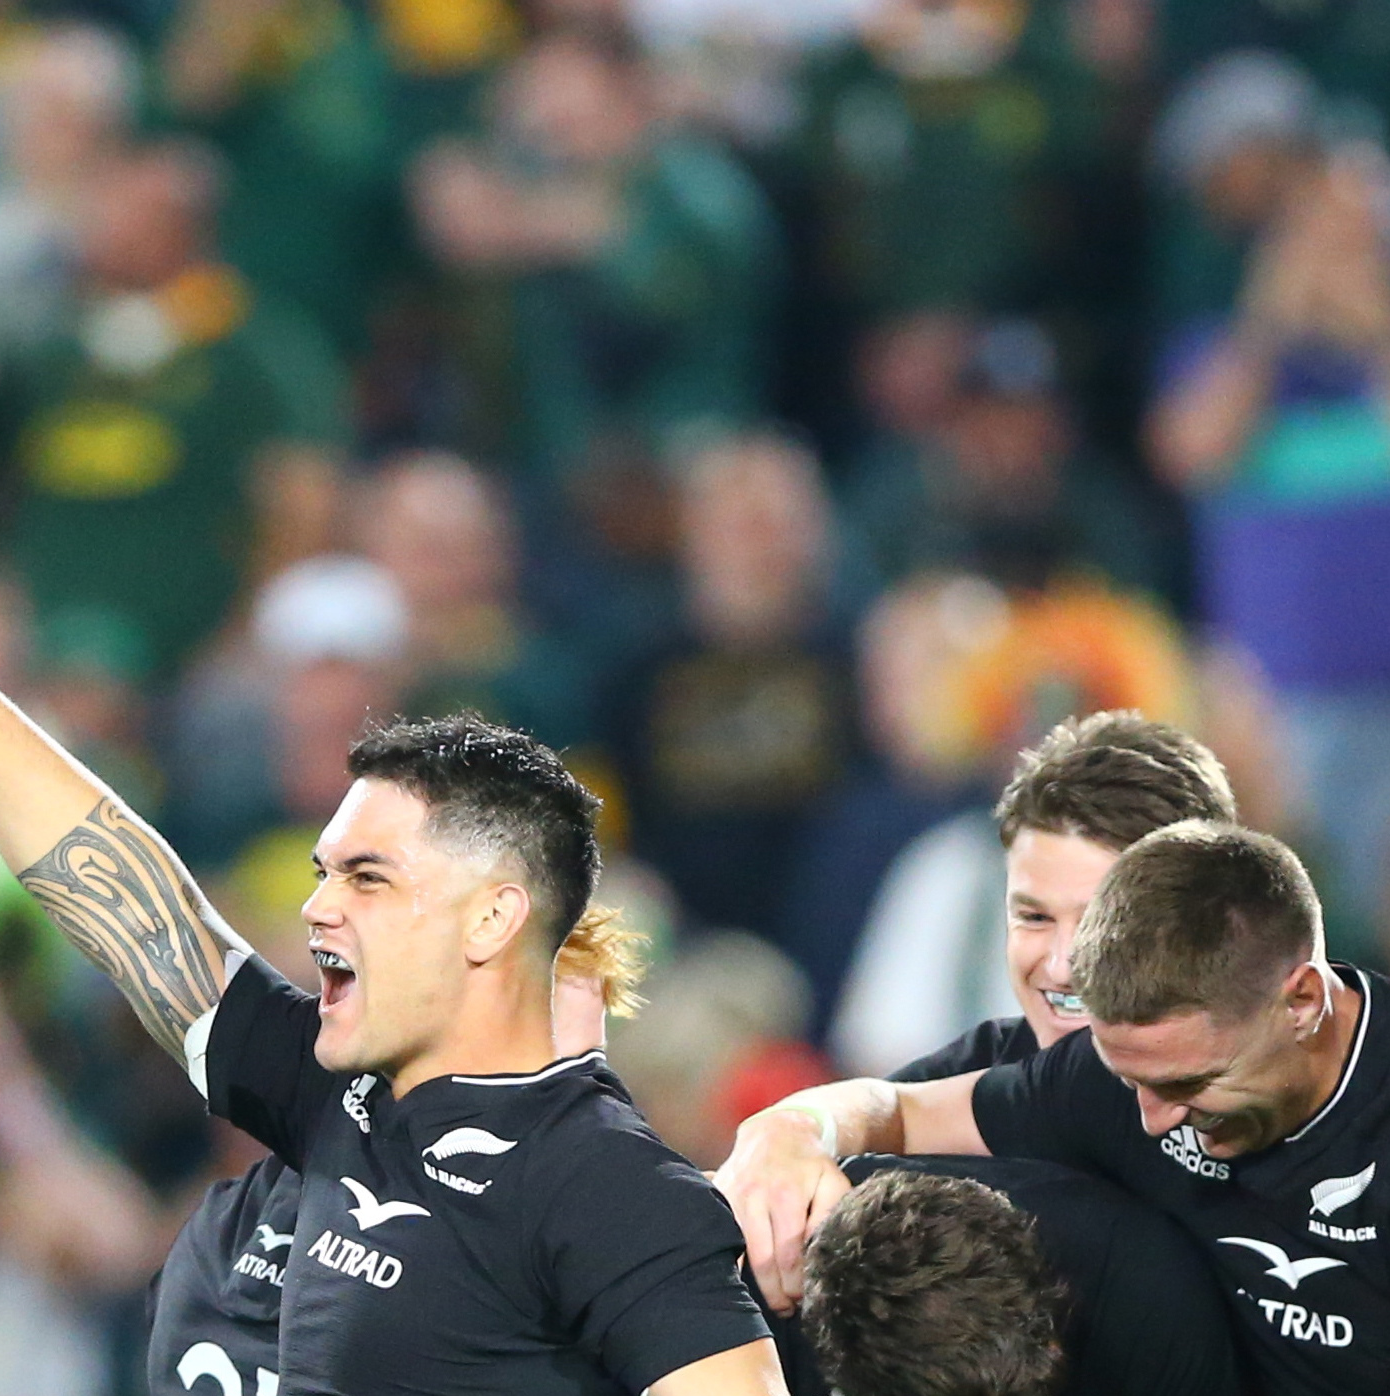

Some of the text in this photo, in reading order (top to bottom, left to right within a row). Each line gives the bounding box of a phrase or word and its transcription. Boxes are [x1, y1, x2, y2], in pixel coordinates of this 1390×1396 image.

[1161, 1138, 1231, 1180] adidas
[1329, 1225, 1377, 1242] BLACK
[307, 1230, 403, 1289] ALTRAD
[1238, 1288, 1353, 1347] TRAD
